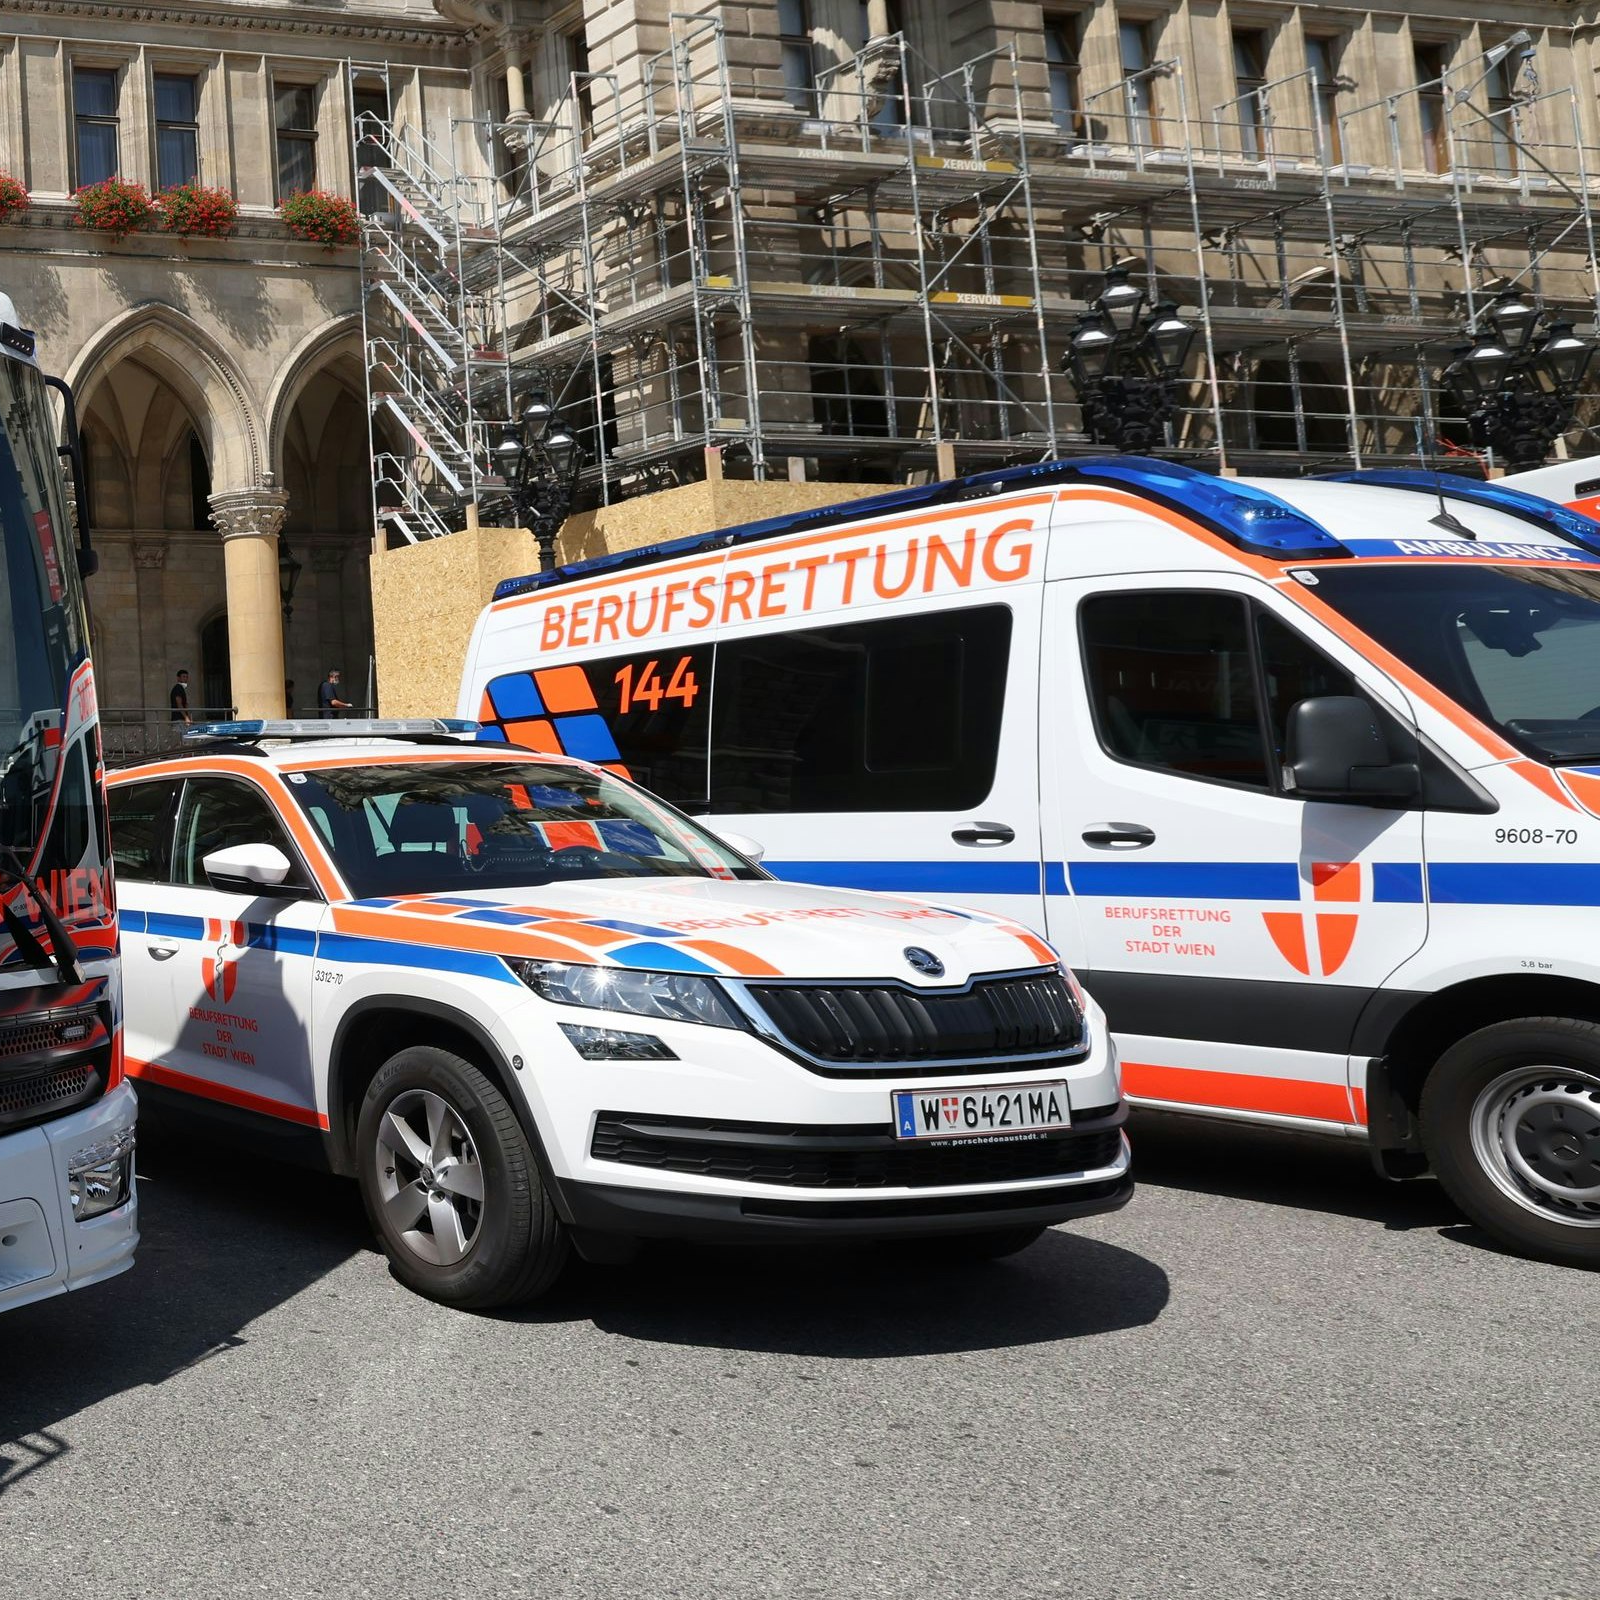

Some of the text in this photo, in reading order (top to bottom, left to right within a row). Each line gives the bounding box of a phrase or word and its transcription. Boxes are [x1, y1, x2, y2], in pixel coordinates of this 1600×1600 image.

[943, 158, 987, 171] XERVON
[1084, 168, 1128, 181] XERVON
[1235, 178, 1277, 191] XERVON
[956, 293, 1001, 305] XERVON
[1393, 540, 1581, 562] AMBULANCE
[540, 519, 1034, 652] BERUFSRETTUNG
[614, 655, 699, 714] 144
[1495, 828, 1578, 844] 9608-70
[22, 867, 113, 922] WIEN
[659, 907, 958, 931] BERUFSRETTUNG
[1105, 906, 1231, 922] BERUFSRETTUNG
[1152, 925, 1182, 937] DER
[1126, 940, 1215, 956] STADT WIEN
[1538, 961, 1552, 969] bar
[315, 970, 344, 985] 3312-70
[189, 1007, 258, 1032] BERUFSRETTUNG
[216, 1030, 233, 1044] DER
[202, 1042, 256, 1066] STADT WIEN
